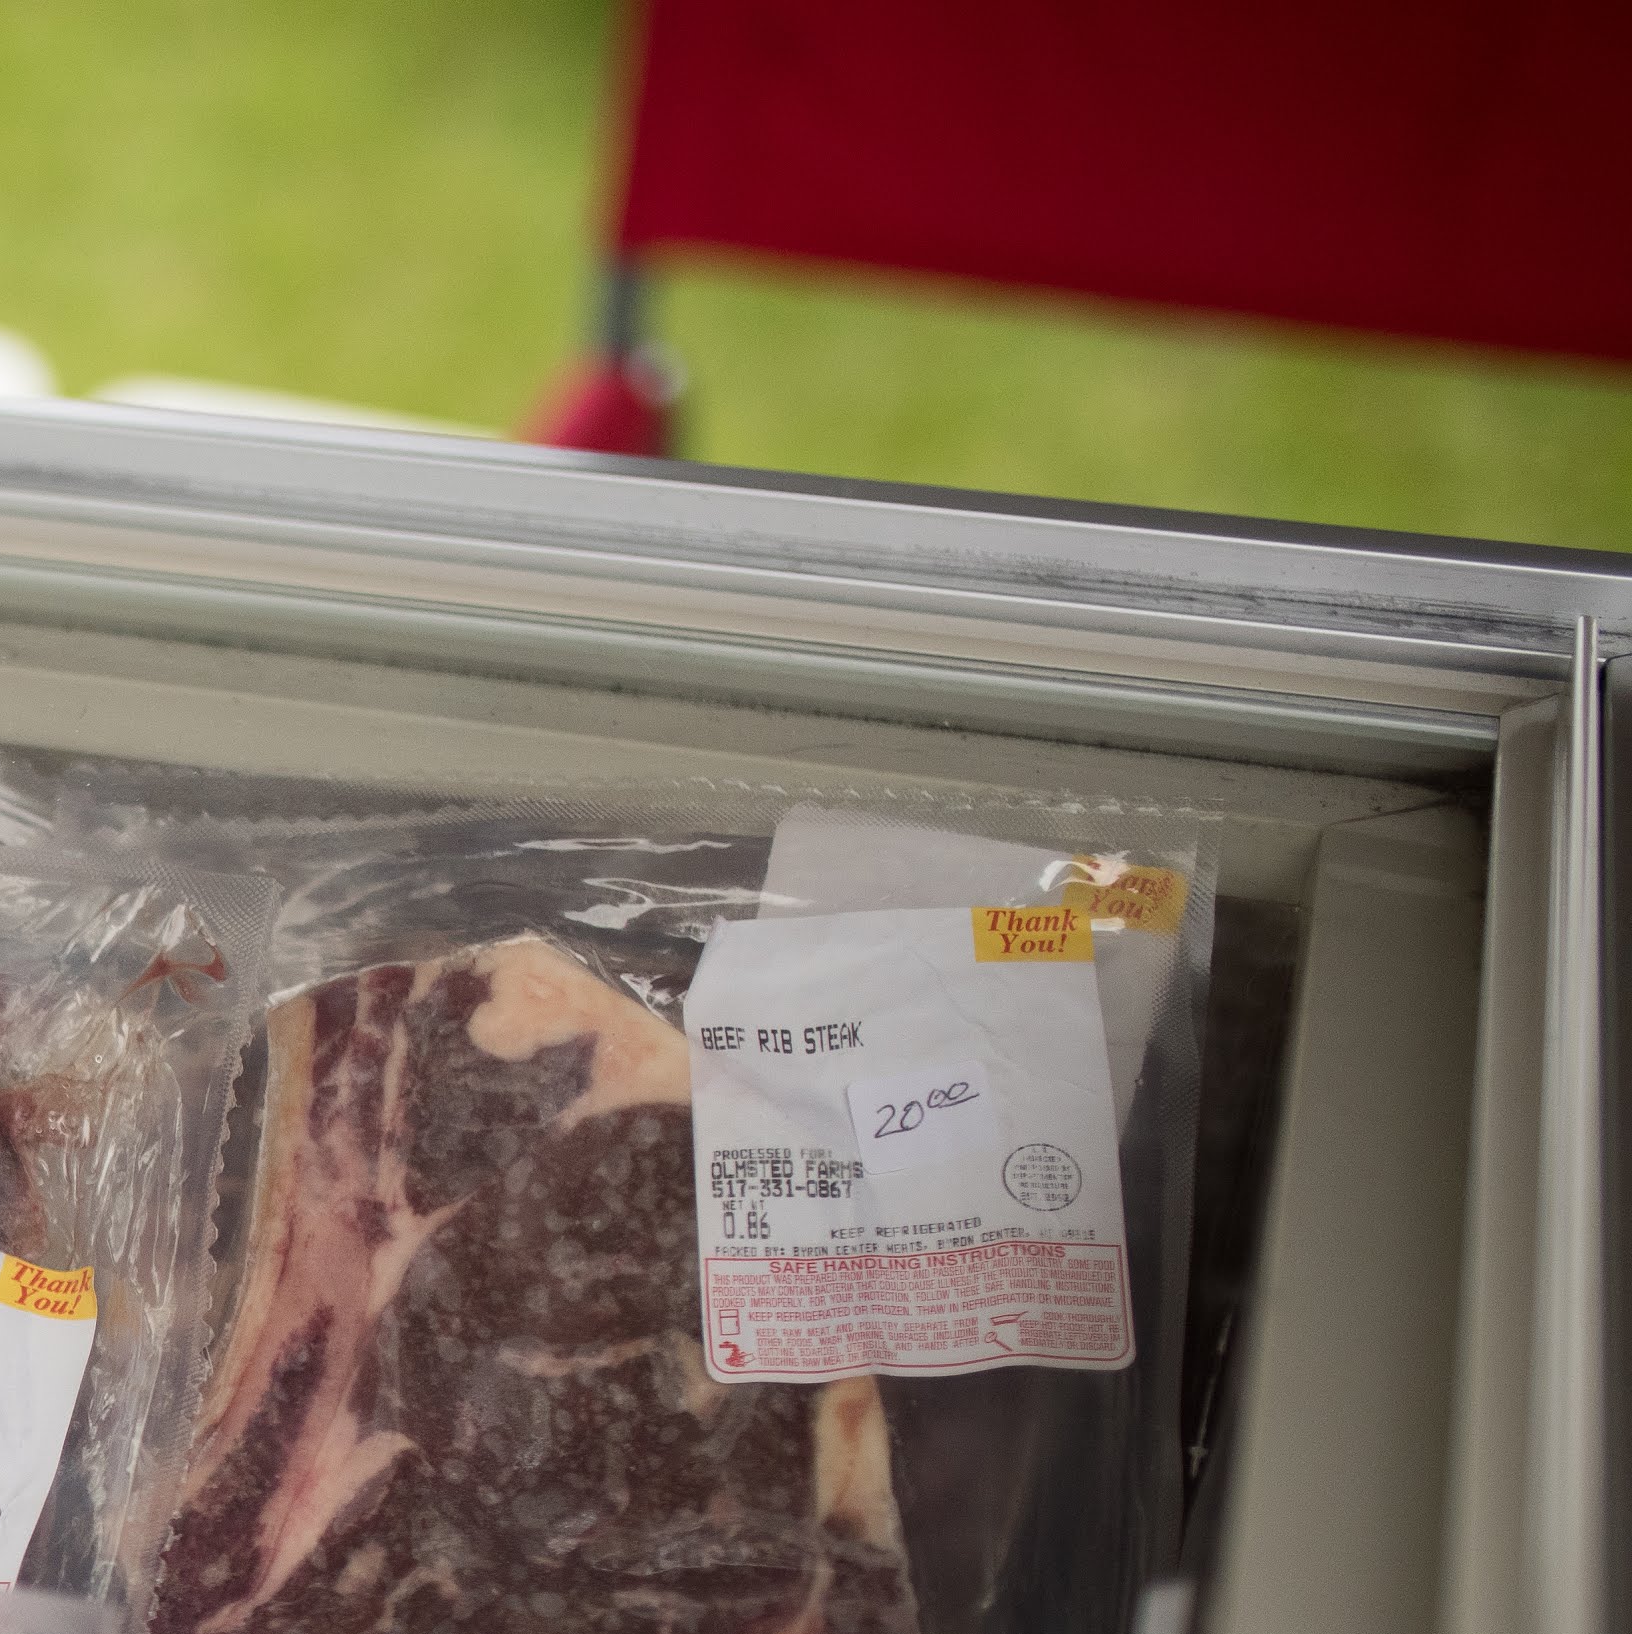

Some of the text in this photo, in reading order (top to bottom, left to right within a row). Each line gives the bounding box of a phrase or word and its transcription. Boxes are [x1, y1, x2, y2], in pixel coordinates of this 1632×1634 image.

[986, 909, 1079, 932] Thank
[999, 933, 1068, 954] You!
[701, 1021, 864, 1054] BEEF RIB STEAK
[713, 1148, 791, 1160] PROCESSED
[711, 1160, 864, 1179] OLMSTED FARMS
[711, 1179, 852, 1199] 517-331-0867
[723, 1200, 743, 1211] NET
[830, 1216, 982, 1239] KEEP REFRIGERATED
[769, 1244, 1066, 1274] SAFE HANDLING INSTRUCTIONS
[11, 1261, 92, 1295] Thank
[14, 1284, 82, 1315] You!
[749, 1312, 773, 1321] KEEP
[776, 1306, 850, 1322] REFRIGERATED
